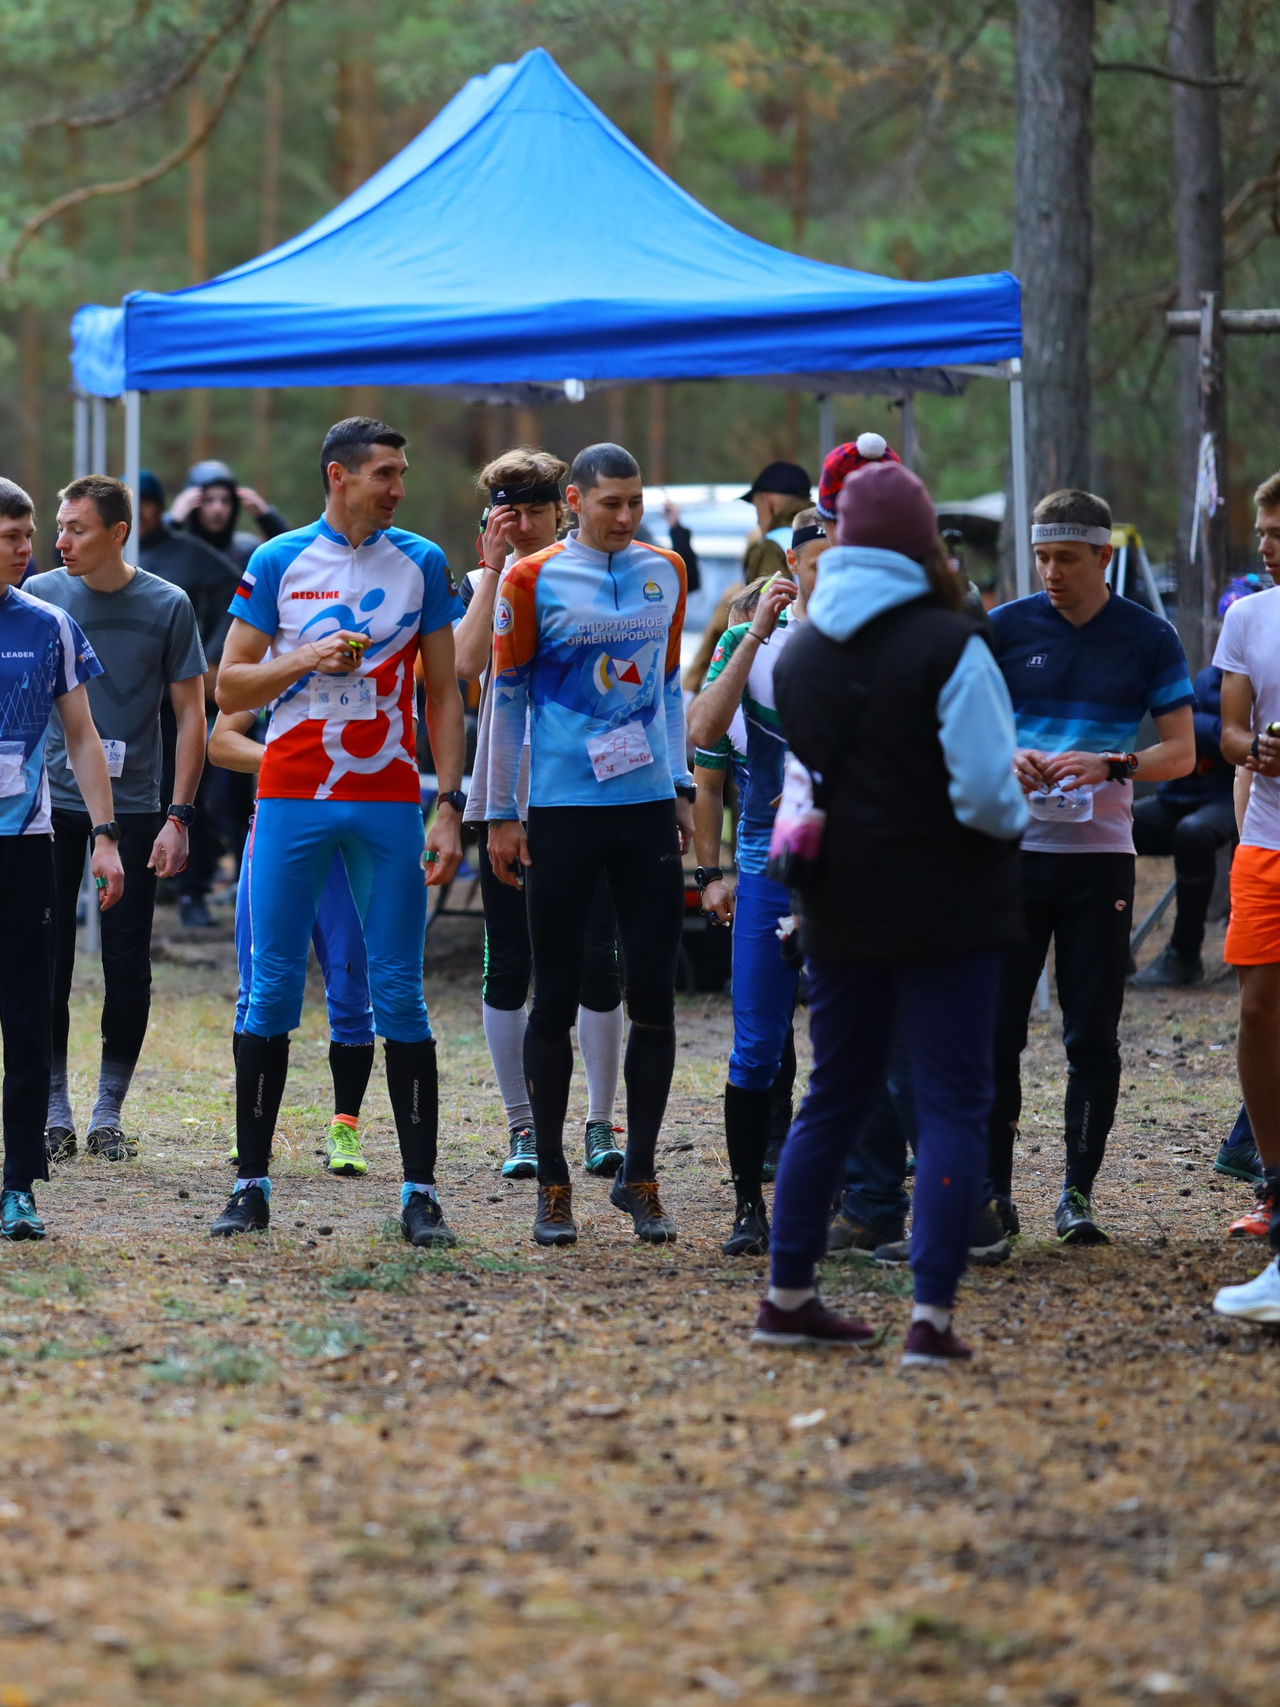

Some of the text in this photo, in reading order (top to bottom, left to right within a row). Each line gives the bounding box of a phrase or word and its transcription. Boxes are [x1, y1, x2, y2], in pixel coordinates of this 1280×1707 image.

[291, 591, 340, 600] REDLINE
[578, 618, 663, 633] СПОРТИВНОЕ
[1, 651, 35, 659] LEADER
[340, 691, 349, 706] 6
[1056, 795, 1065, 808] 2
